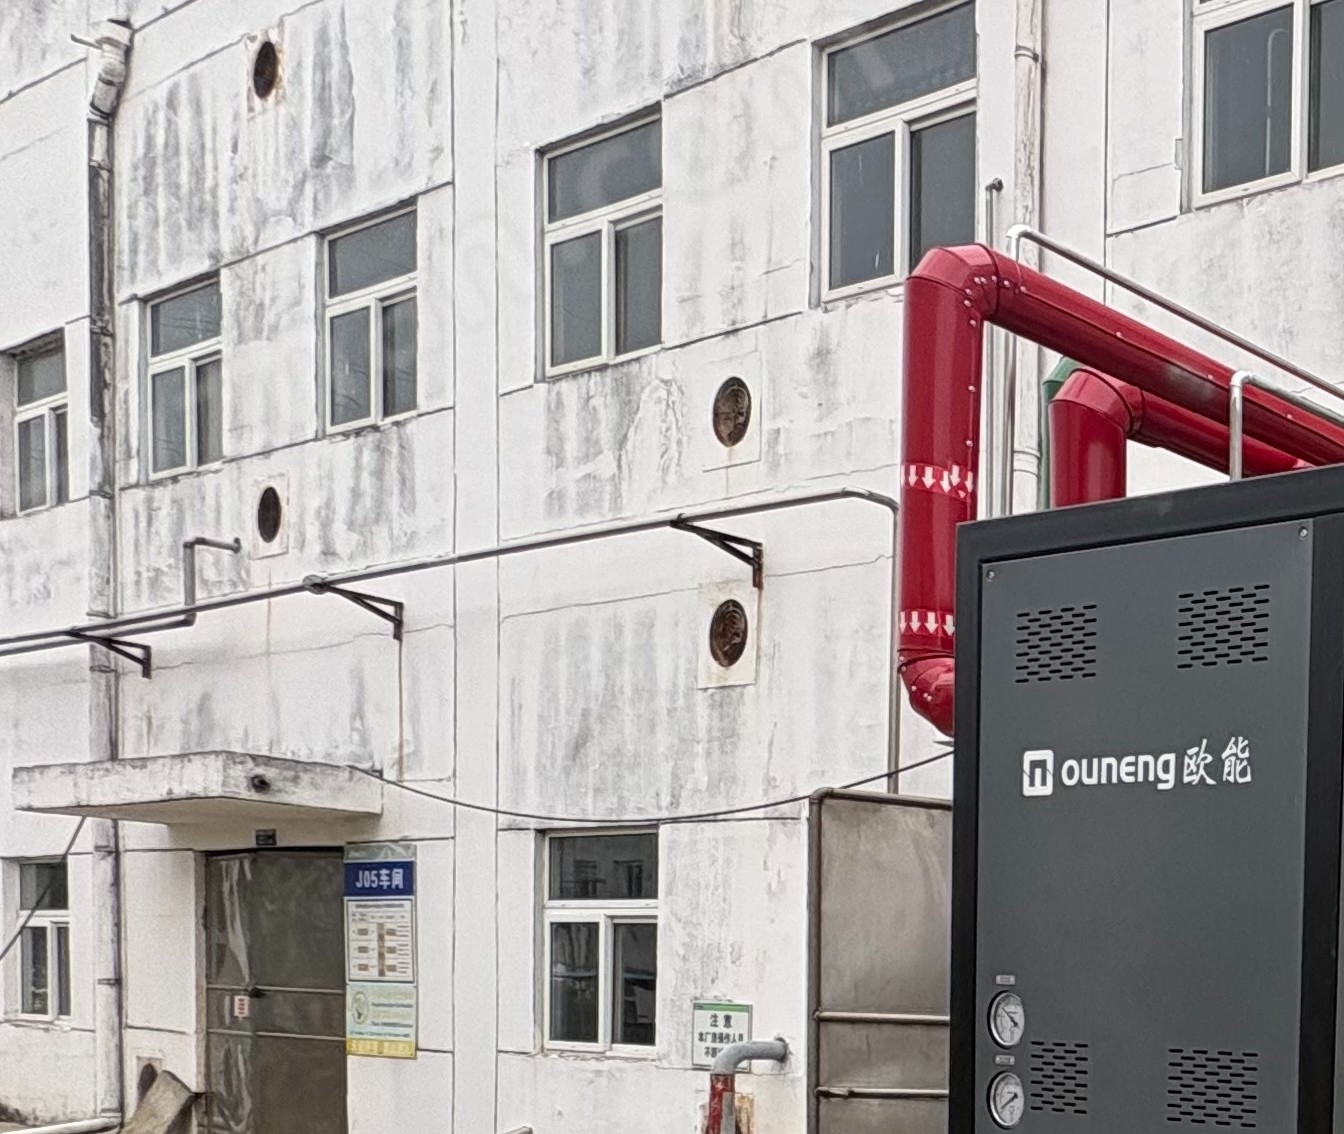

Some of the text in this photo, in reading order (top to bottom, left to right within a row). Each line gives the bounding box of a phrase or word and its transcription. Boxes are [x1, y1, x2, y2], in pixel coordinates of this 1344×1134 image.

[1061, 736, 1252, 790] ouneng 欧能
[355, 867, 404, 890] J05车间
